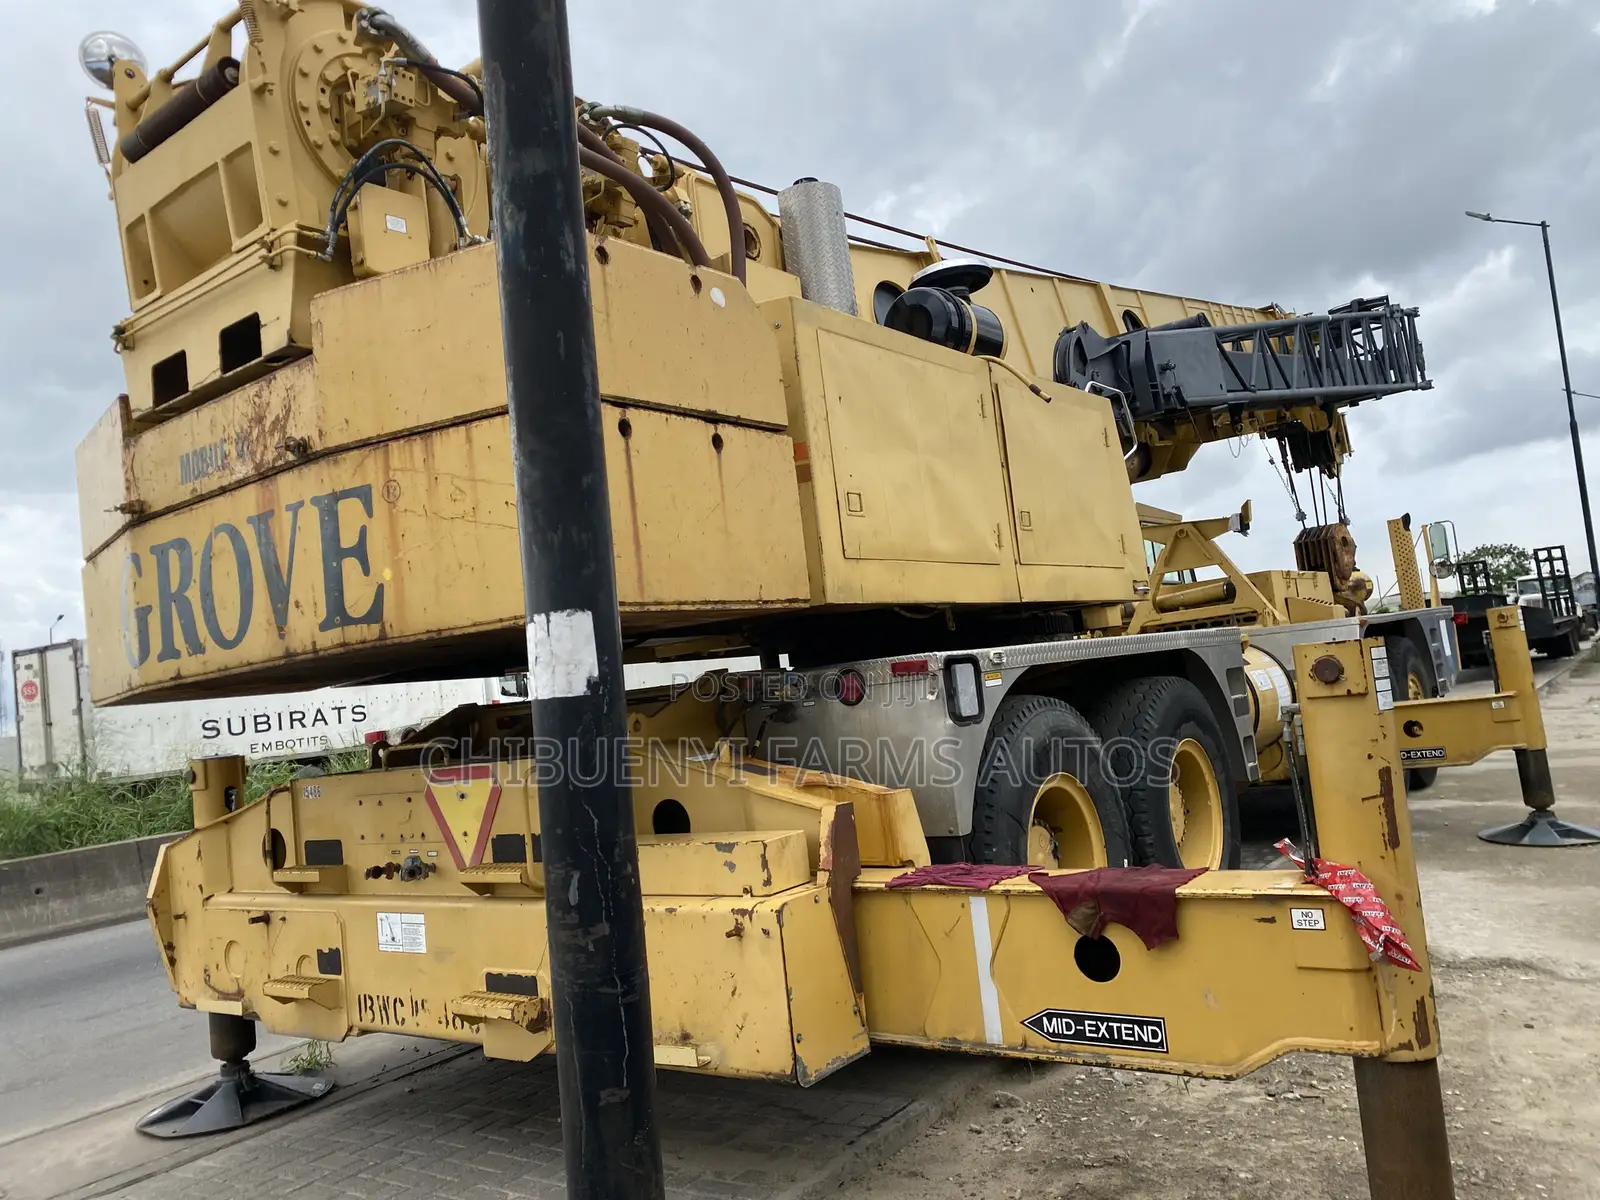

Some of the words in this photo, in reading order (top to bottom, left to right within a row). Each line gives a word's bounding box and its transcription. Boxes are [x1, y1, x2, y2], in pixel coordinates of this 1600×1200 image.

[121, 483, 385, 670] GROVE
[201, 704, 367, 740] SUBIRATS
[250, 734, 328, 754] EMBOTITS
[1400, 749, 1445, 759] D-EXTEND
[1296, 919, 1320, 928] STEP
[1301, 911, 1314, 919] NO
[1042, 1016, 1162, 1043] MID-EXTEND
